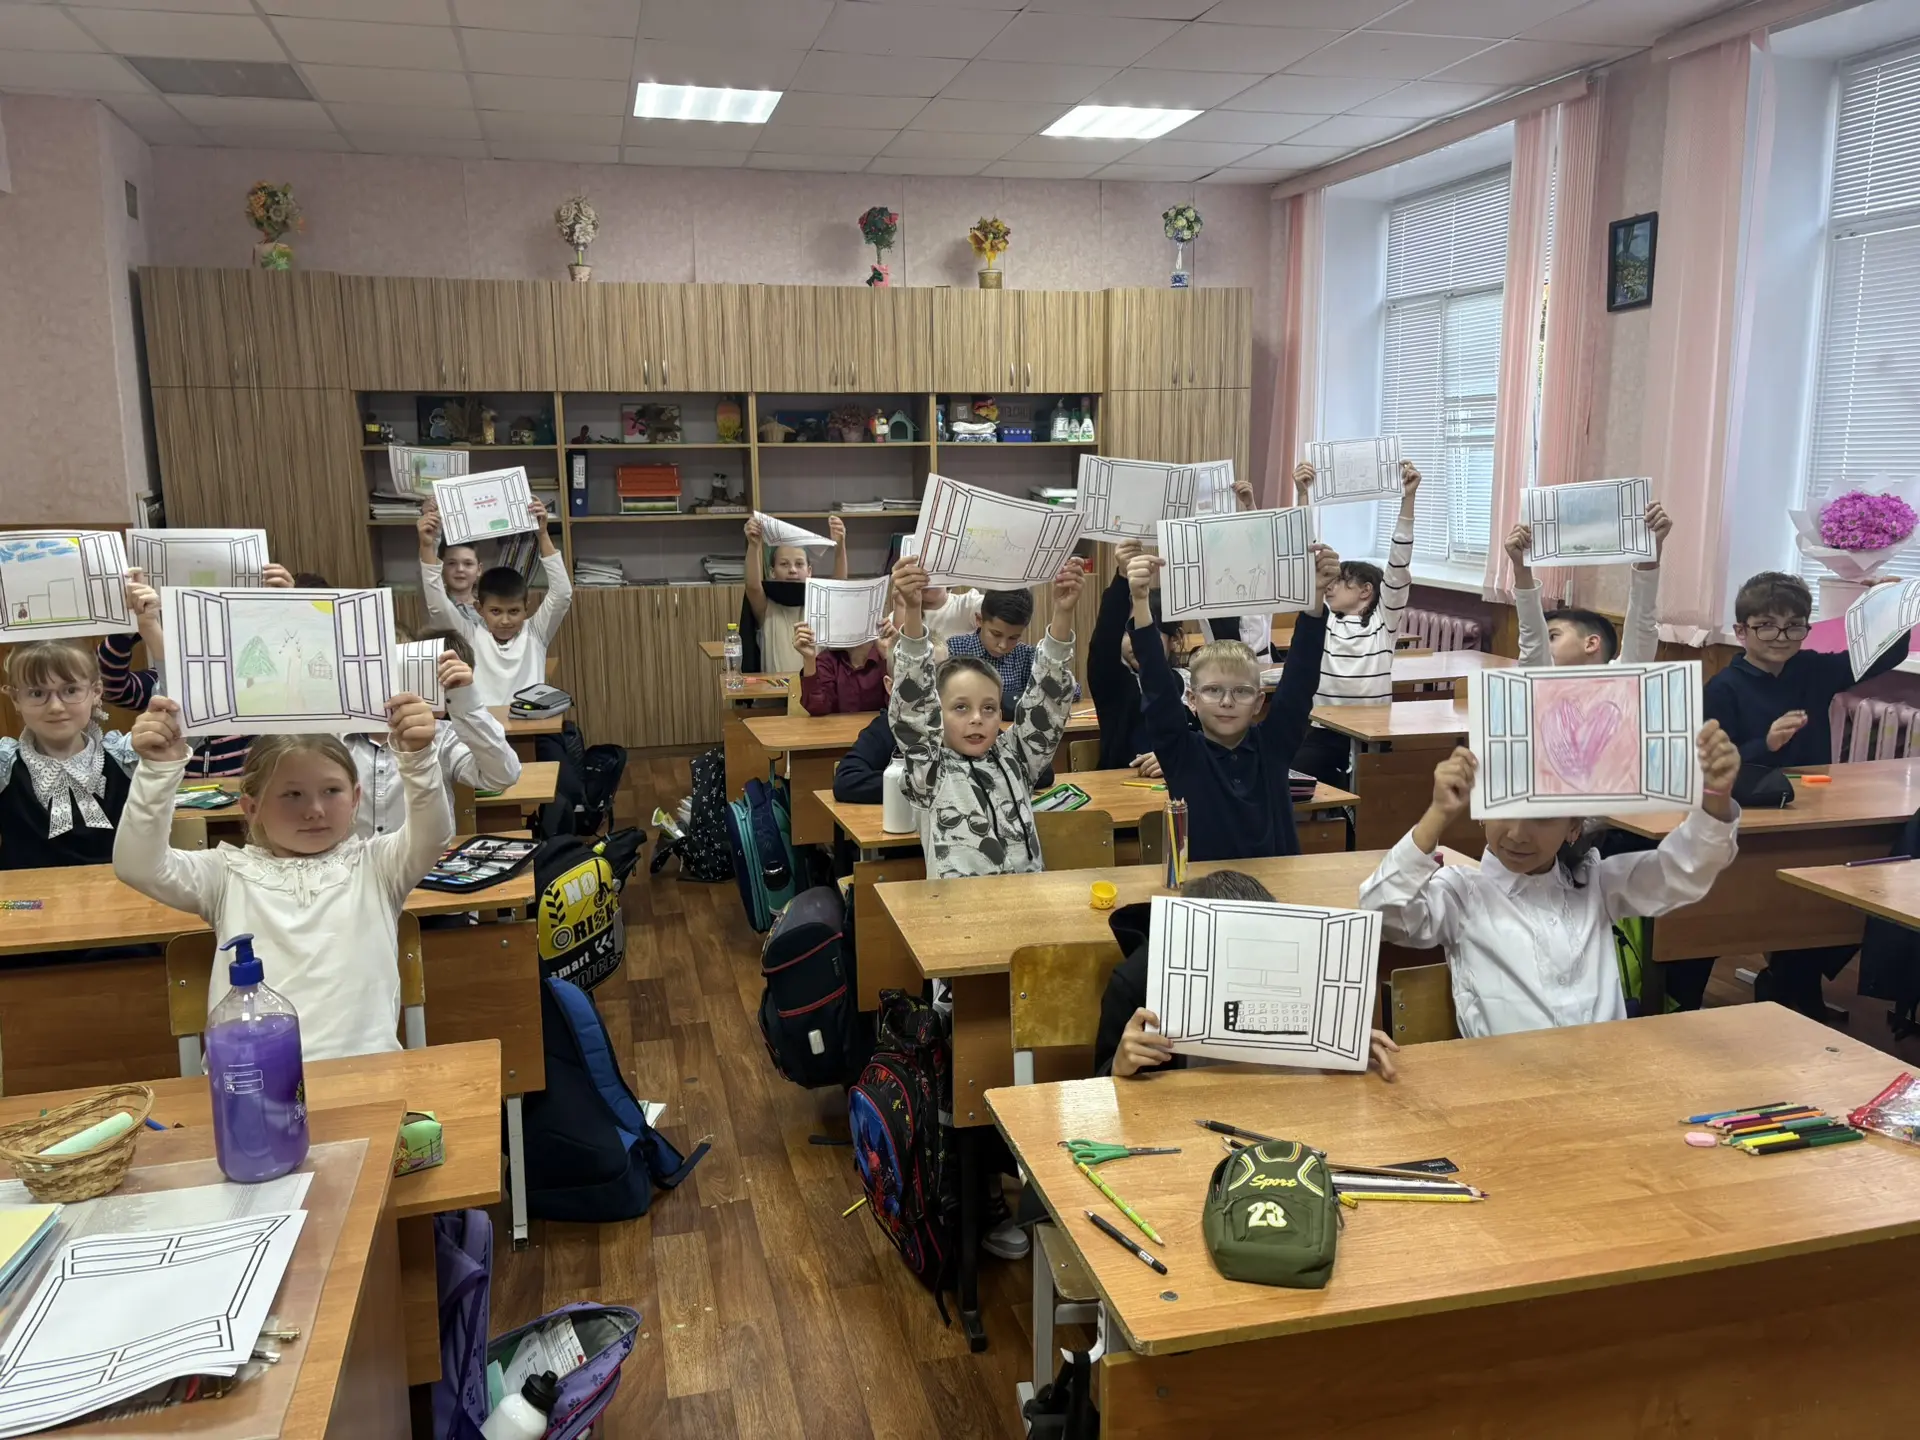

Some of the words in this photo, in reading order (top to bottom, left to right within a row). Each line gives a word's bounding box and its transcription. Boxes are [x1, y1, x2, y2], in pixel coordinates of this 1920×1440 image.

[562, 871, 597, 907] NO
[1249, 1174, 1298, 1190] Sport
[1247, 1201, 1288, 1228] 23
